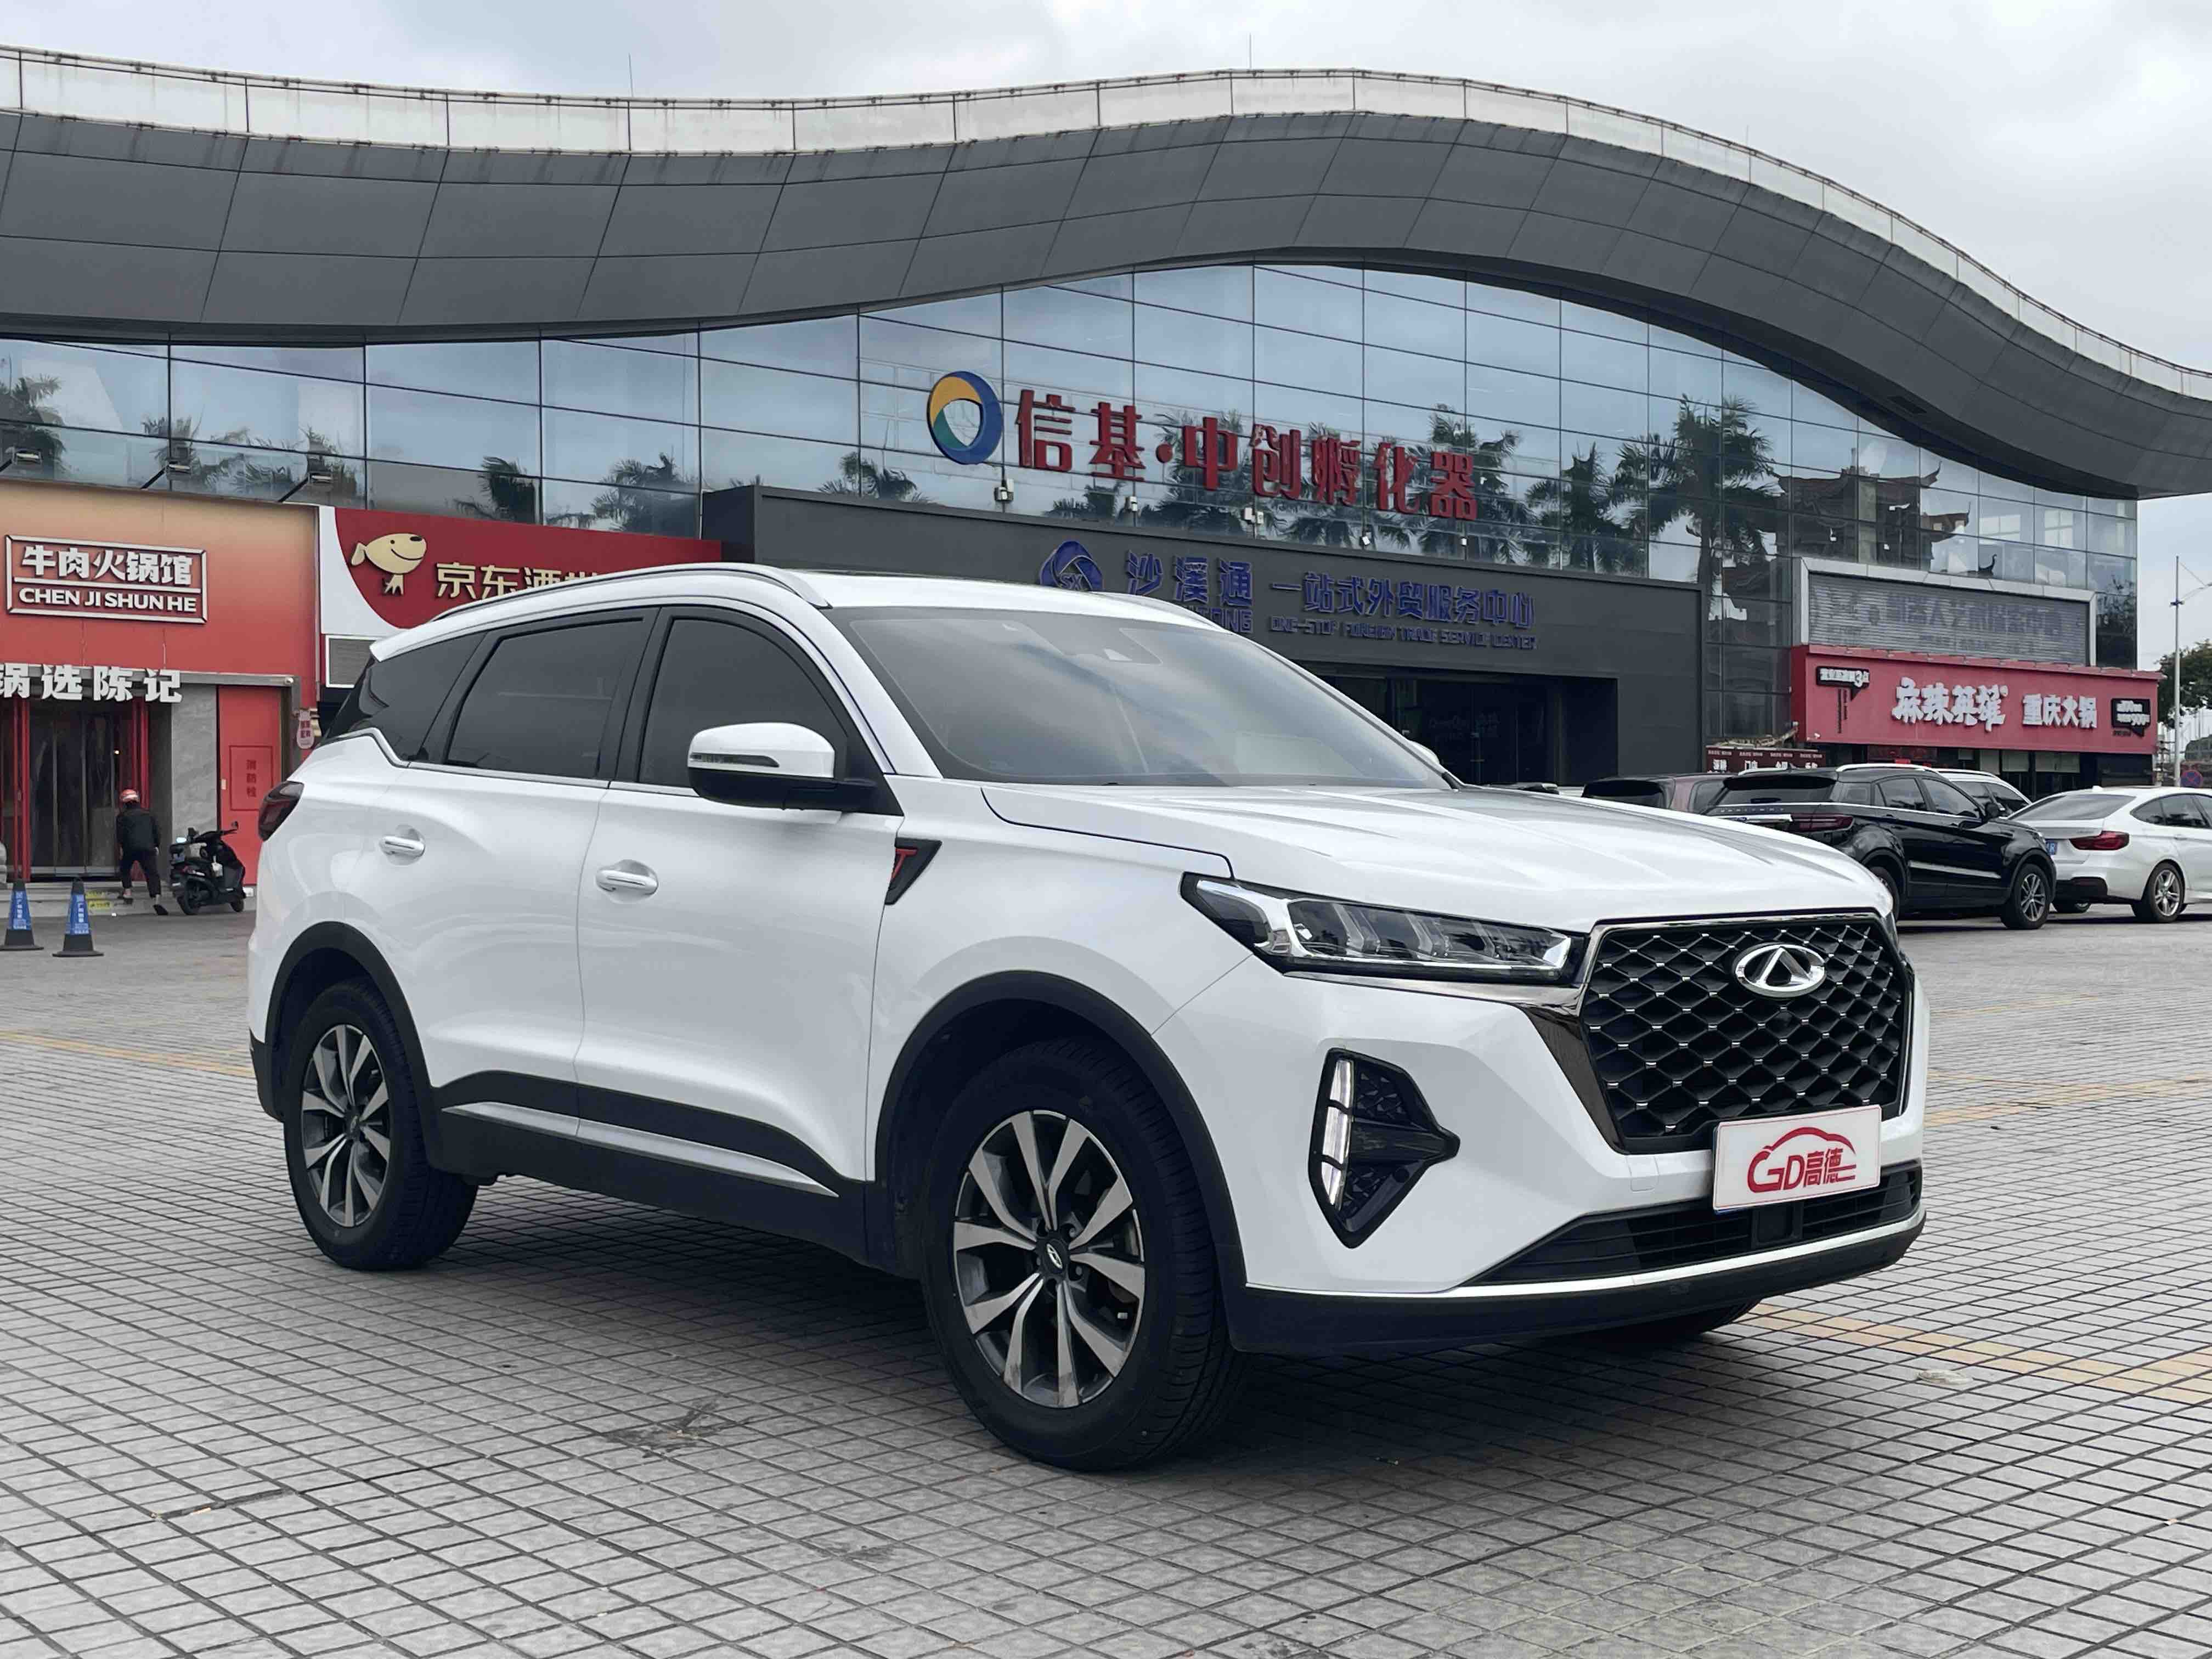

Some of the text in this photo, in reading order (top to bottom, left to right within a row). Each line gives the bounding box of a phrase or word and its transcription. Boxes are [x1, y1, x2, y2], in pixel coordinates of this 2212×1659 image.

[22, 545, 193, 585] 牛肉火锅馆
[19, 588, 196, 612] CHEN JI SHUN HE
[1126, 550, 1535, 629] 沙溪通 一站式外贸服务中心
